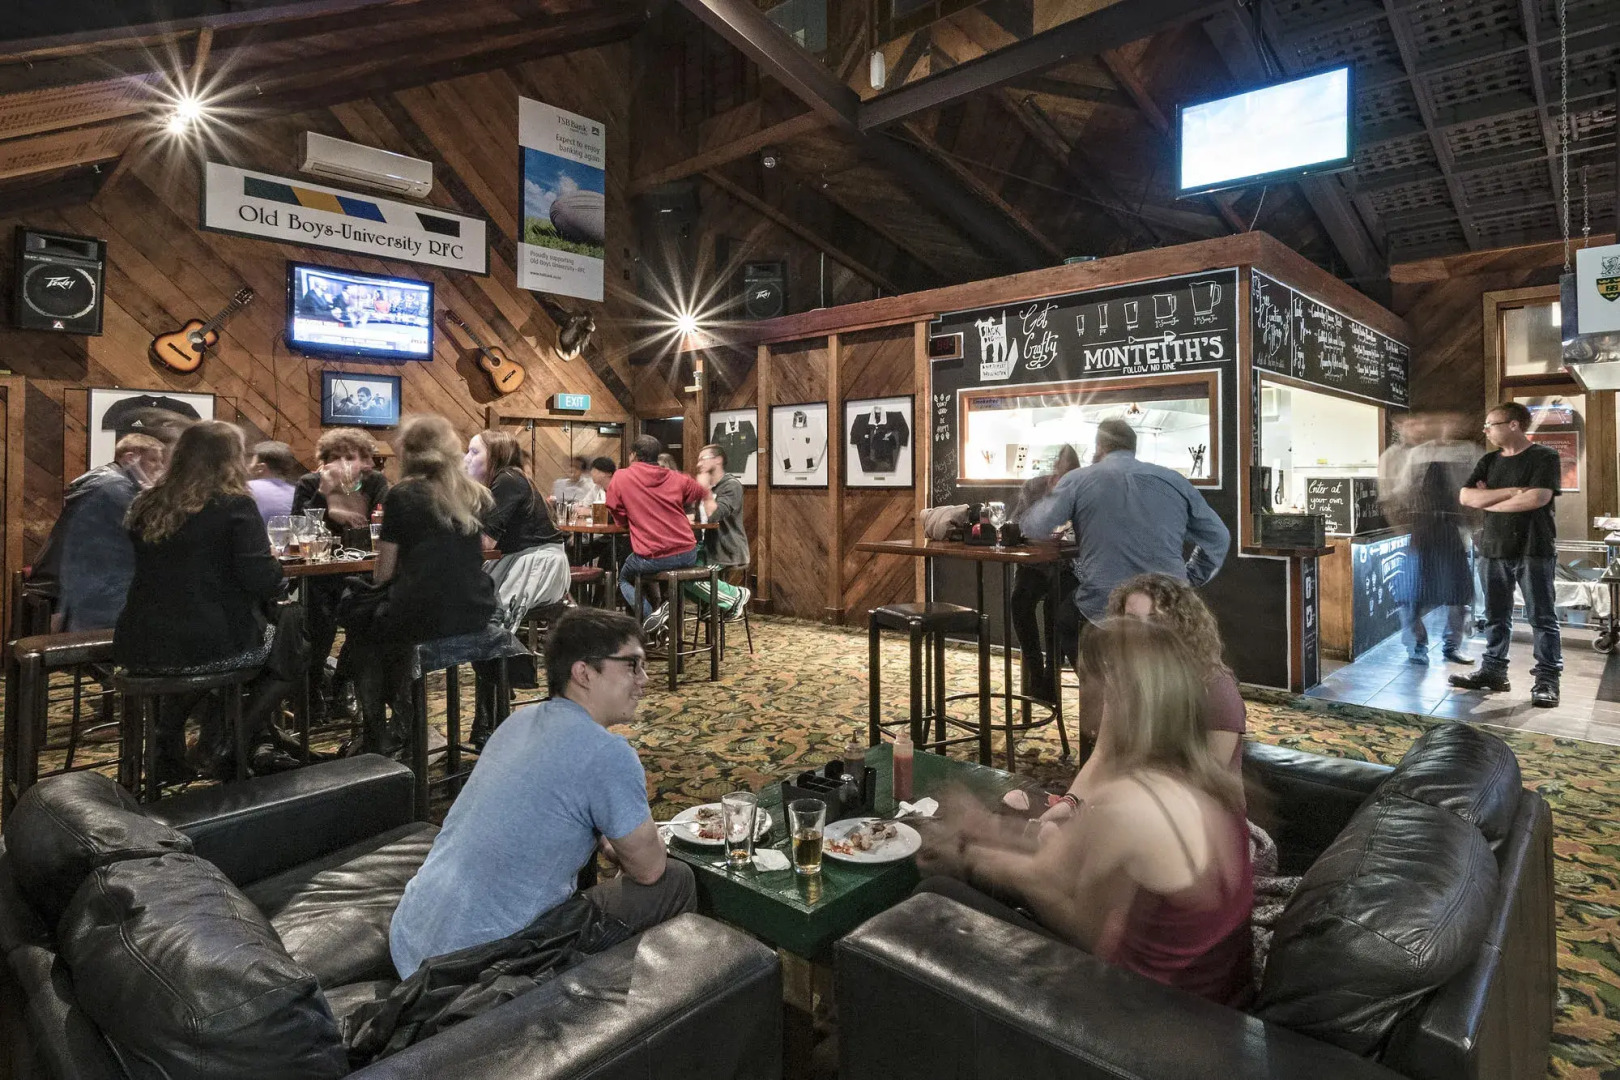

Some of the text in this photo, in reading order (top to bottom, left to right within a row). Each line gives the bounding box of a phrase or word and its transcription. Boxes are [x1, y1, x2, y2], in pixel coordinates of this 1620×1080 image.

[555, 133, 600, 155] Expect to enjoy
[559, 144, 583, 159] banking
[238, 204, 279, 227] Old
[428, 239, 464, 263] RFC
[1019, 302, 1059, 336] Get
[1022, 330, 1060, 370] Crafty
[1083, 335, 1224, 371] MONTEITH'S
[1122, 362, 1177, 375] FOLLOW NO ONE
[565, 395, 585, 408] EXIT
[1308, 479, 1343, 494] Enter at
[1309, 497, 1344, 510] your own
